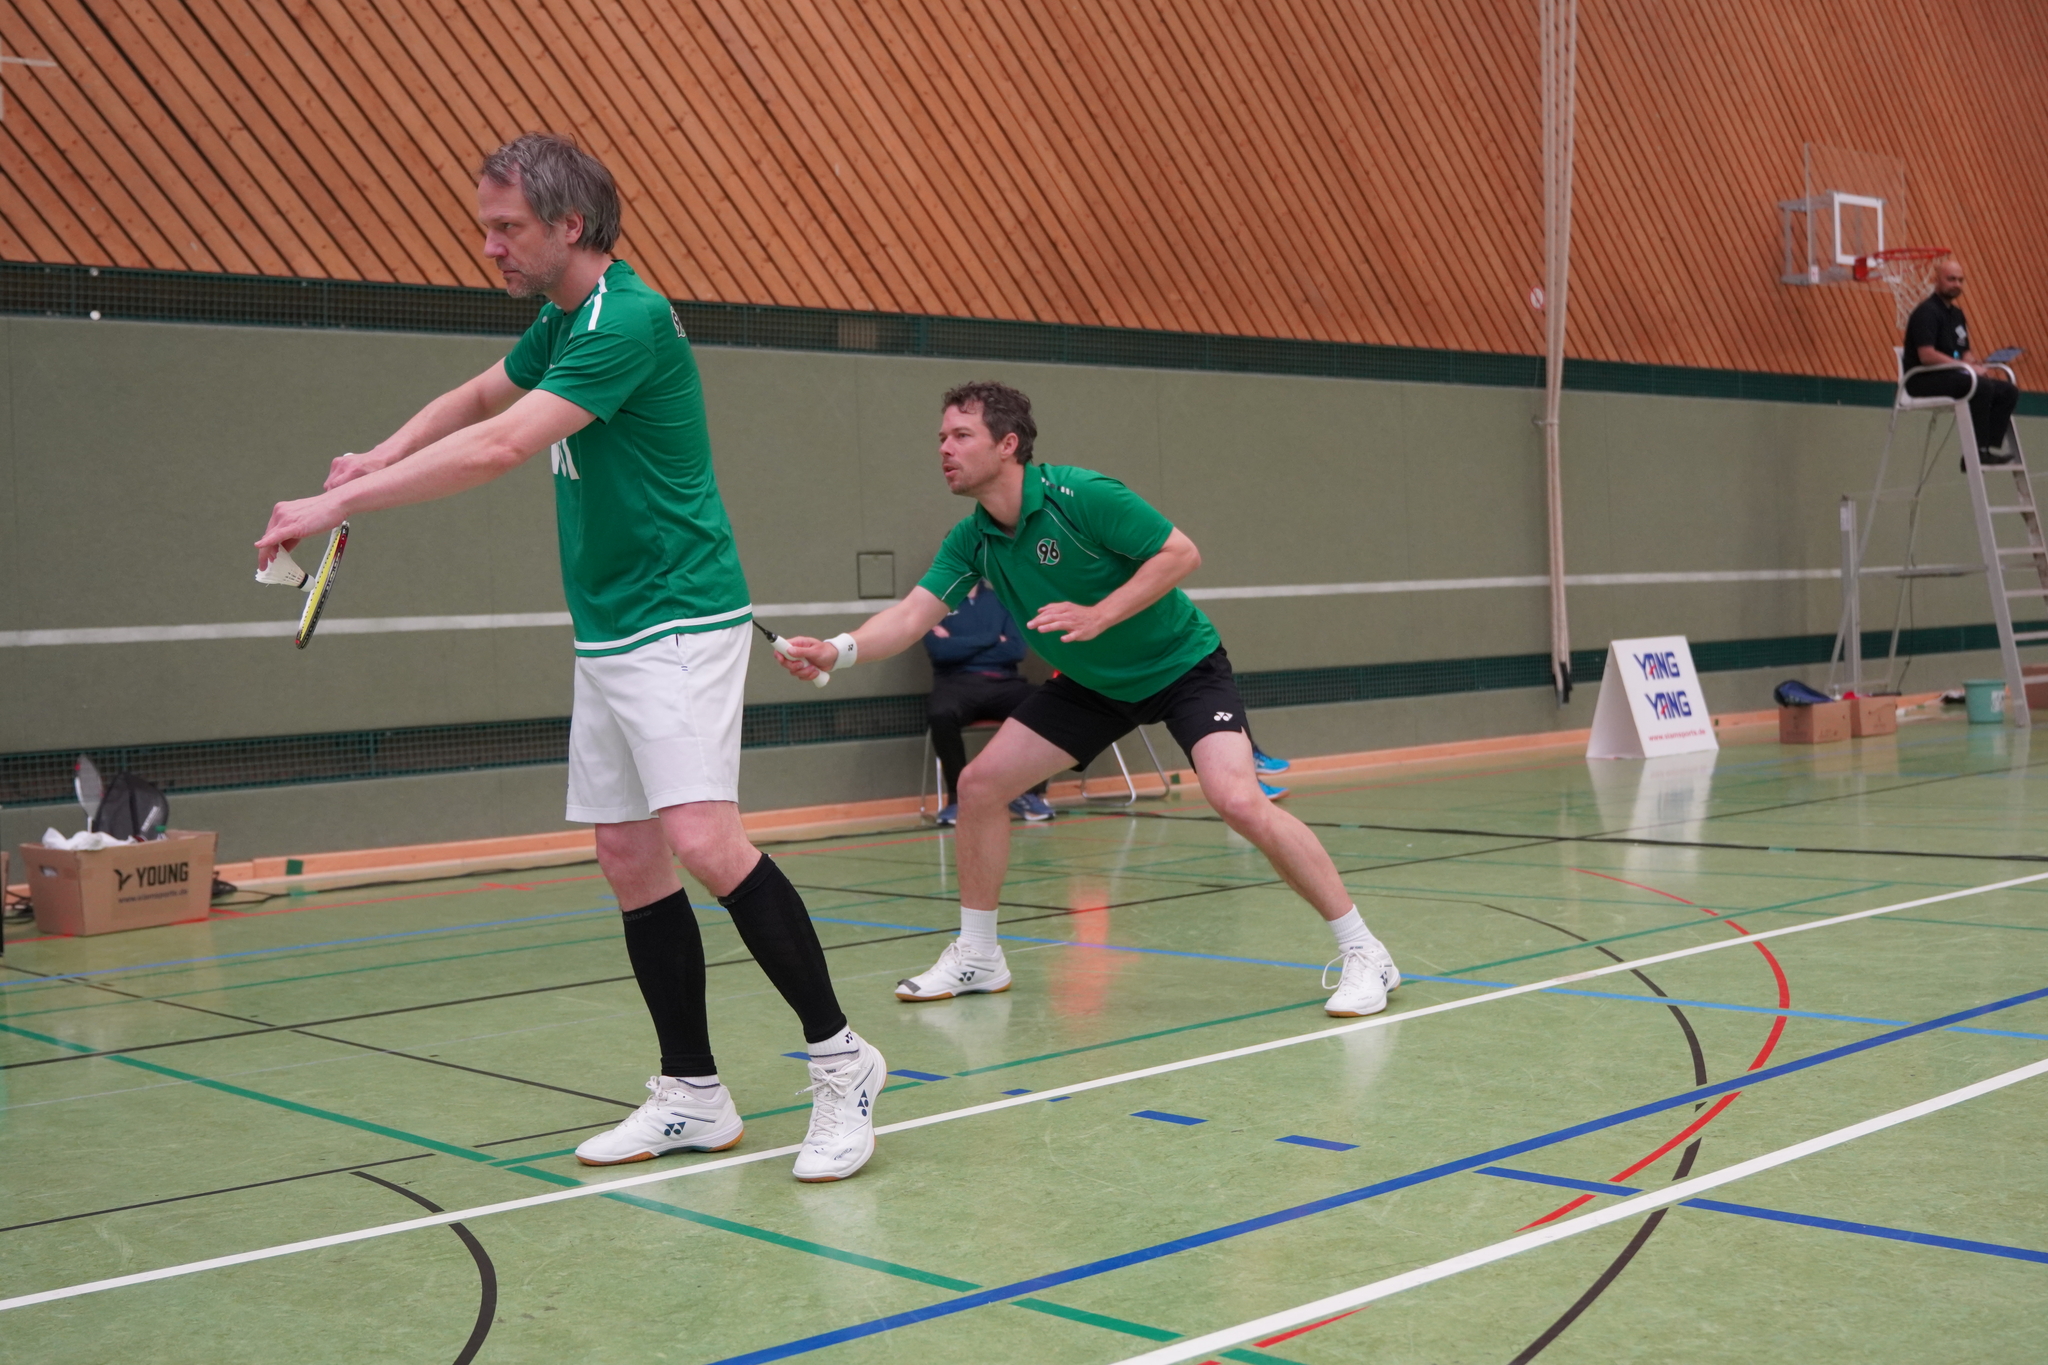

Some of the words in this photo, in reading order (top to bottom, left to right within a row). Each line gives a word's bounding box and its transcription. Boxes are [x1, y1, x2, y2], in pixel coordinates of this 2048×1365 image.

[1038, 540, 1060, 563] 96
[1633, 652, 1680, 680] YANG
[1645, 690, 1692, 720] YANG
[136, 862, 189, 888] YOUNG
